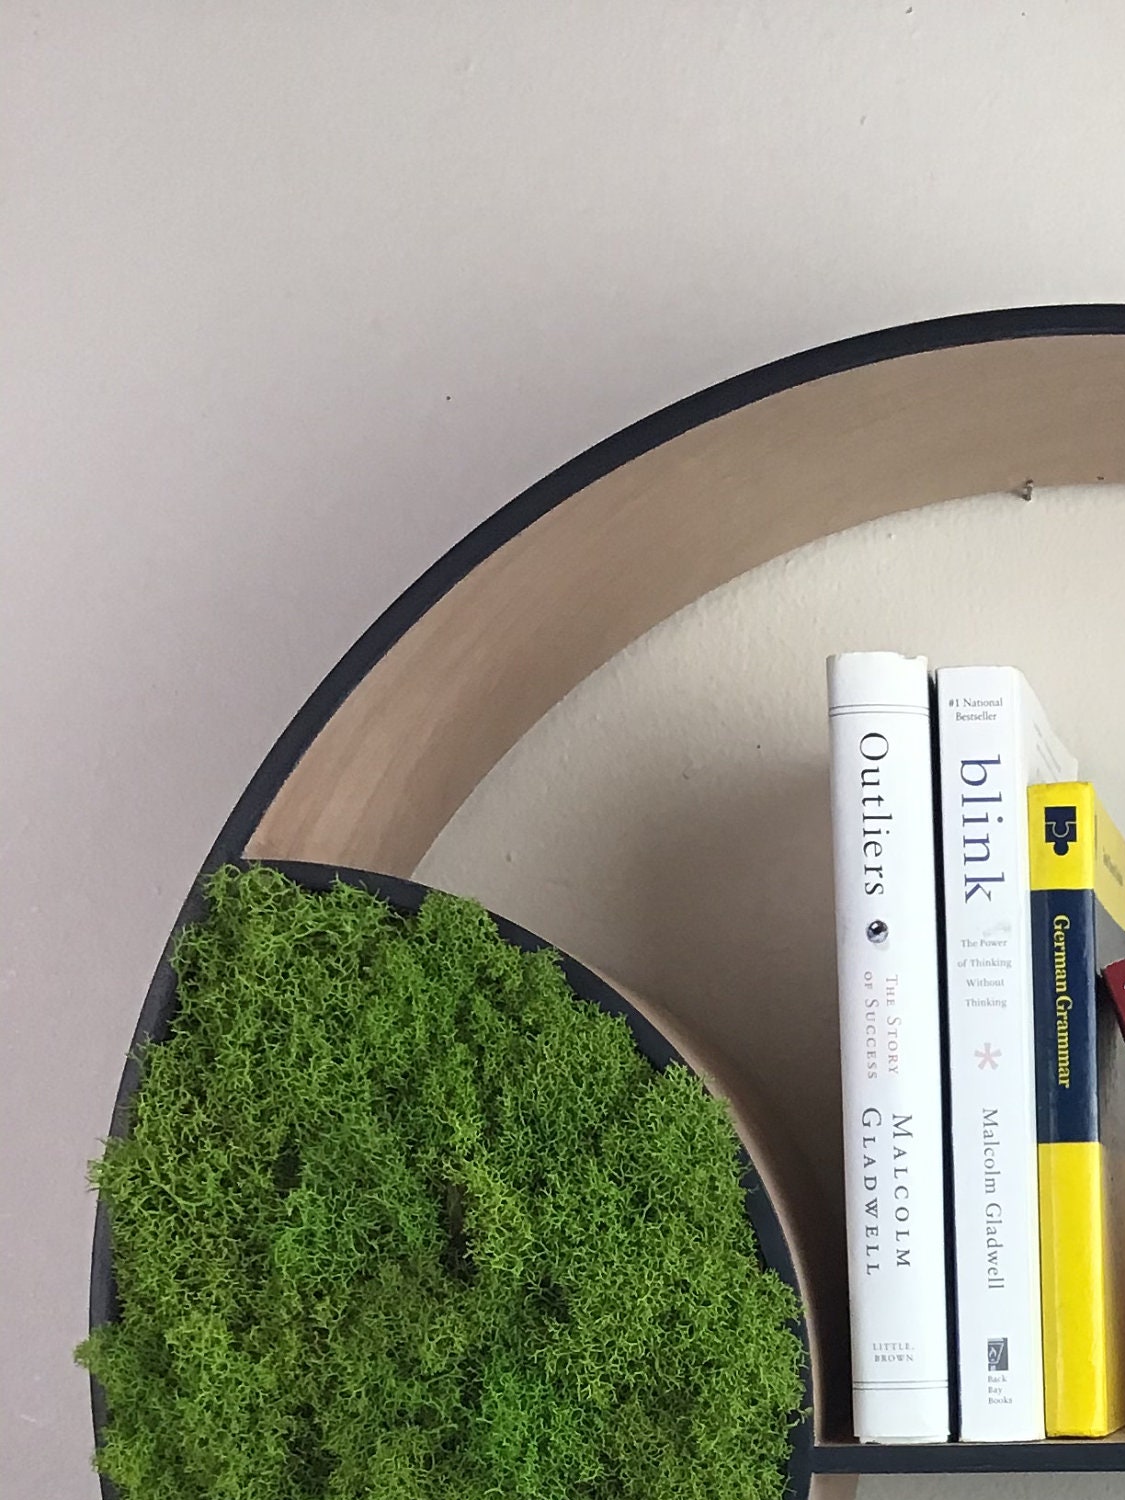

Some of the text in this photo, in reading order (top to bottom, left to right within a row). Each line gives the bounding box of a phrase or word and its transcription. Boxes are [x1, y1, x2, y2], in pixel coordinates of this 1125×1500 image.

[948, 697, 1003, 708] #1 National
[955, 711, 997, 722] Bestseller
[858, 732, 893, 896] Outliers
[960, 754, 1005, 904] blink
[961, 938, 1008, 948] The Power
[957, 957, 1013, 969] of Thinking
[966, 978, 1005, 988] Without
[965, 997, 1008, 1009] Thinking
[1053, 914, 1073, 1089] German Grammar
[885, 974, 902, 1074] THE STORY
[864, 998, 880, 1080] SUCCESS
[861, 1107, 882, 1276] GLADWELL
[892, 1113, 914, 1268] MALCOLM
[982, 1107, 1005, 1290] Malcolm Gladwell
[874, 1353, 914, 1363] BROWN
[987, 1374, 1008, 1383] Back
[988, 1385, 1003, 1395] Bay
[988, 1396, 1013, 1405] Books
